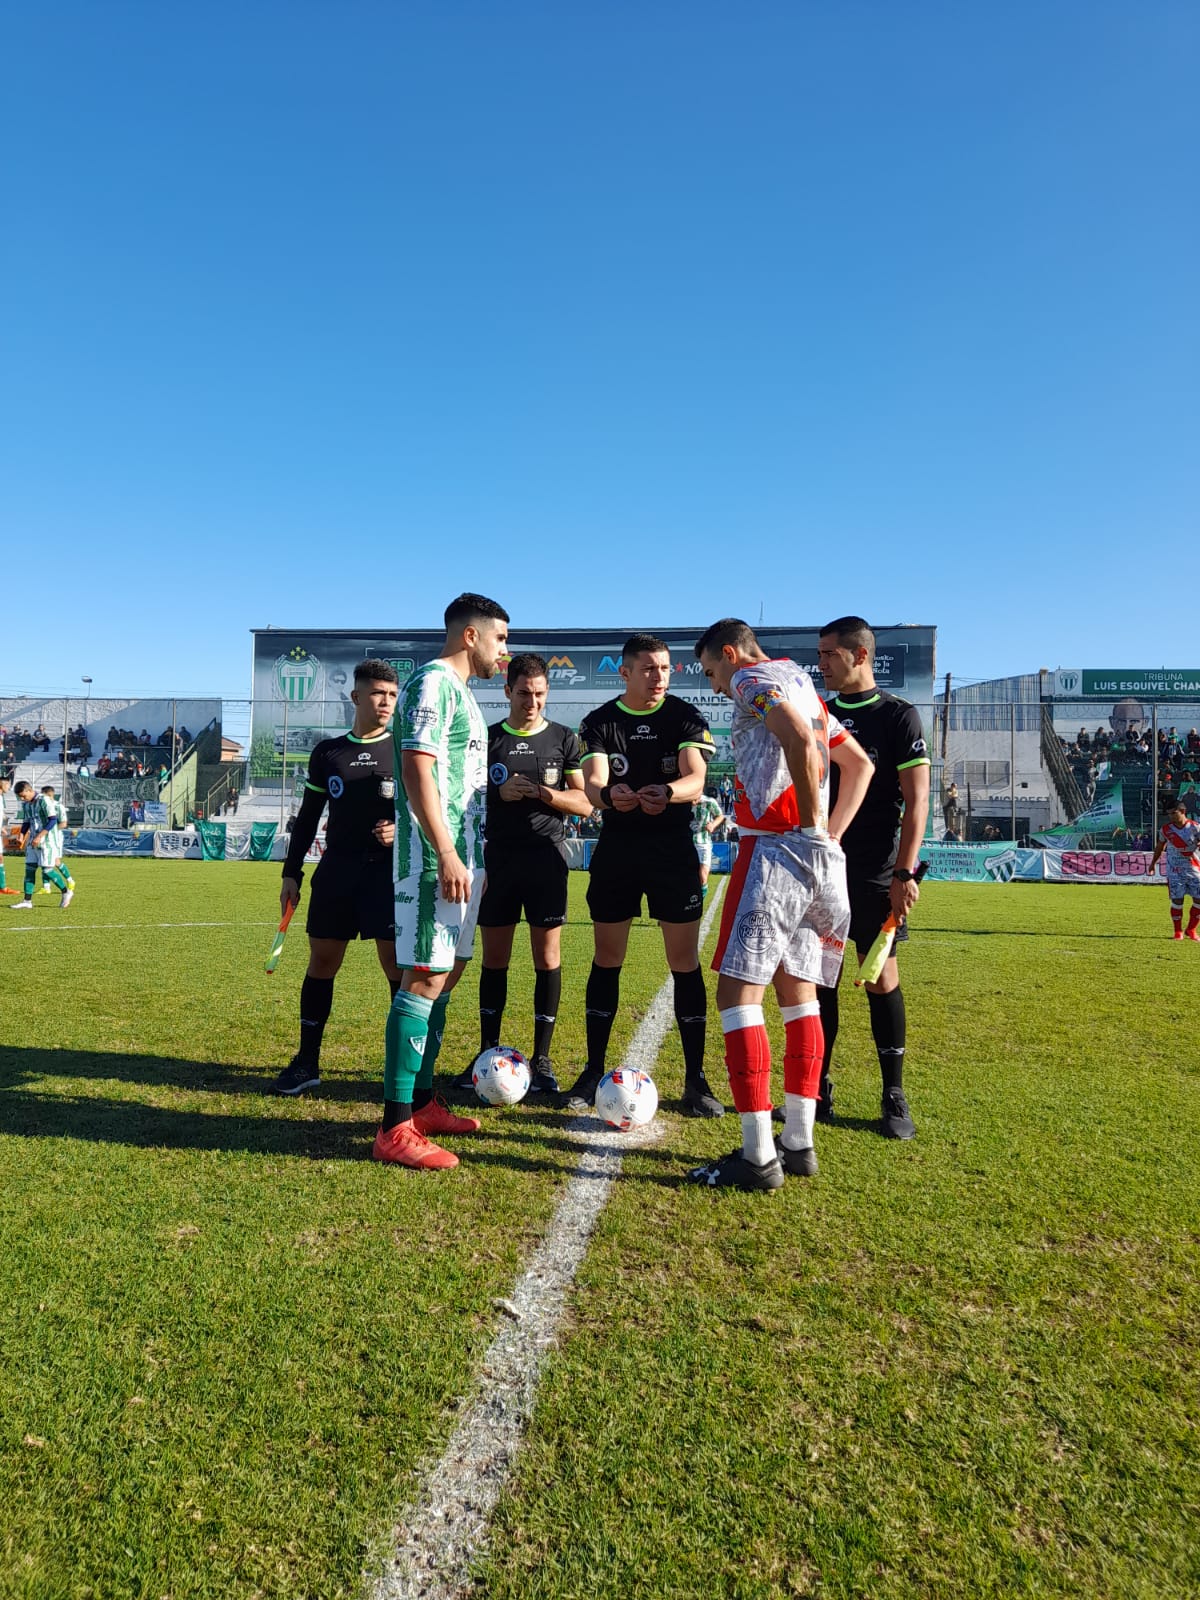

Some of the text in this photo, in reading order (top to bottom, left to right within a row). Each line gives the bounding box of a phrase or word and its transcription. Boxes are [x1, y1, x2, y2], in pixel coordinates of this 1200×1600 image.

[1143, 672, 1184, 681] TRIBUNA
[1094, 681, 1118, 691] LUIS
[1120, 681, 1171, 691] ESQUIVEL
